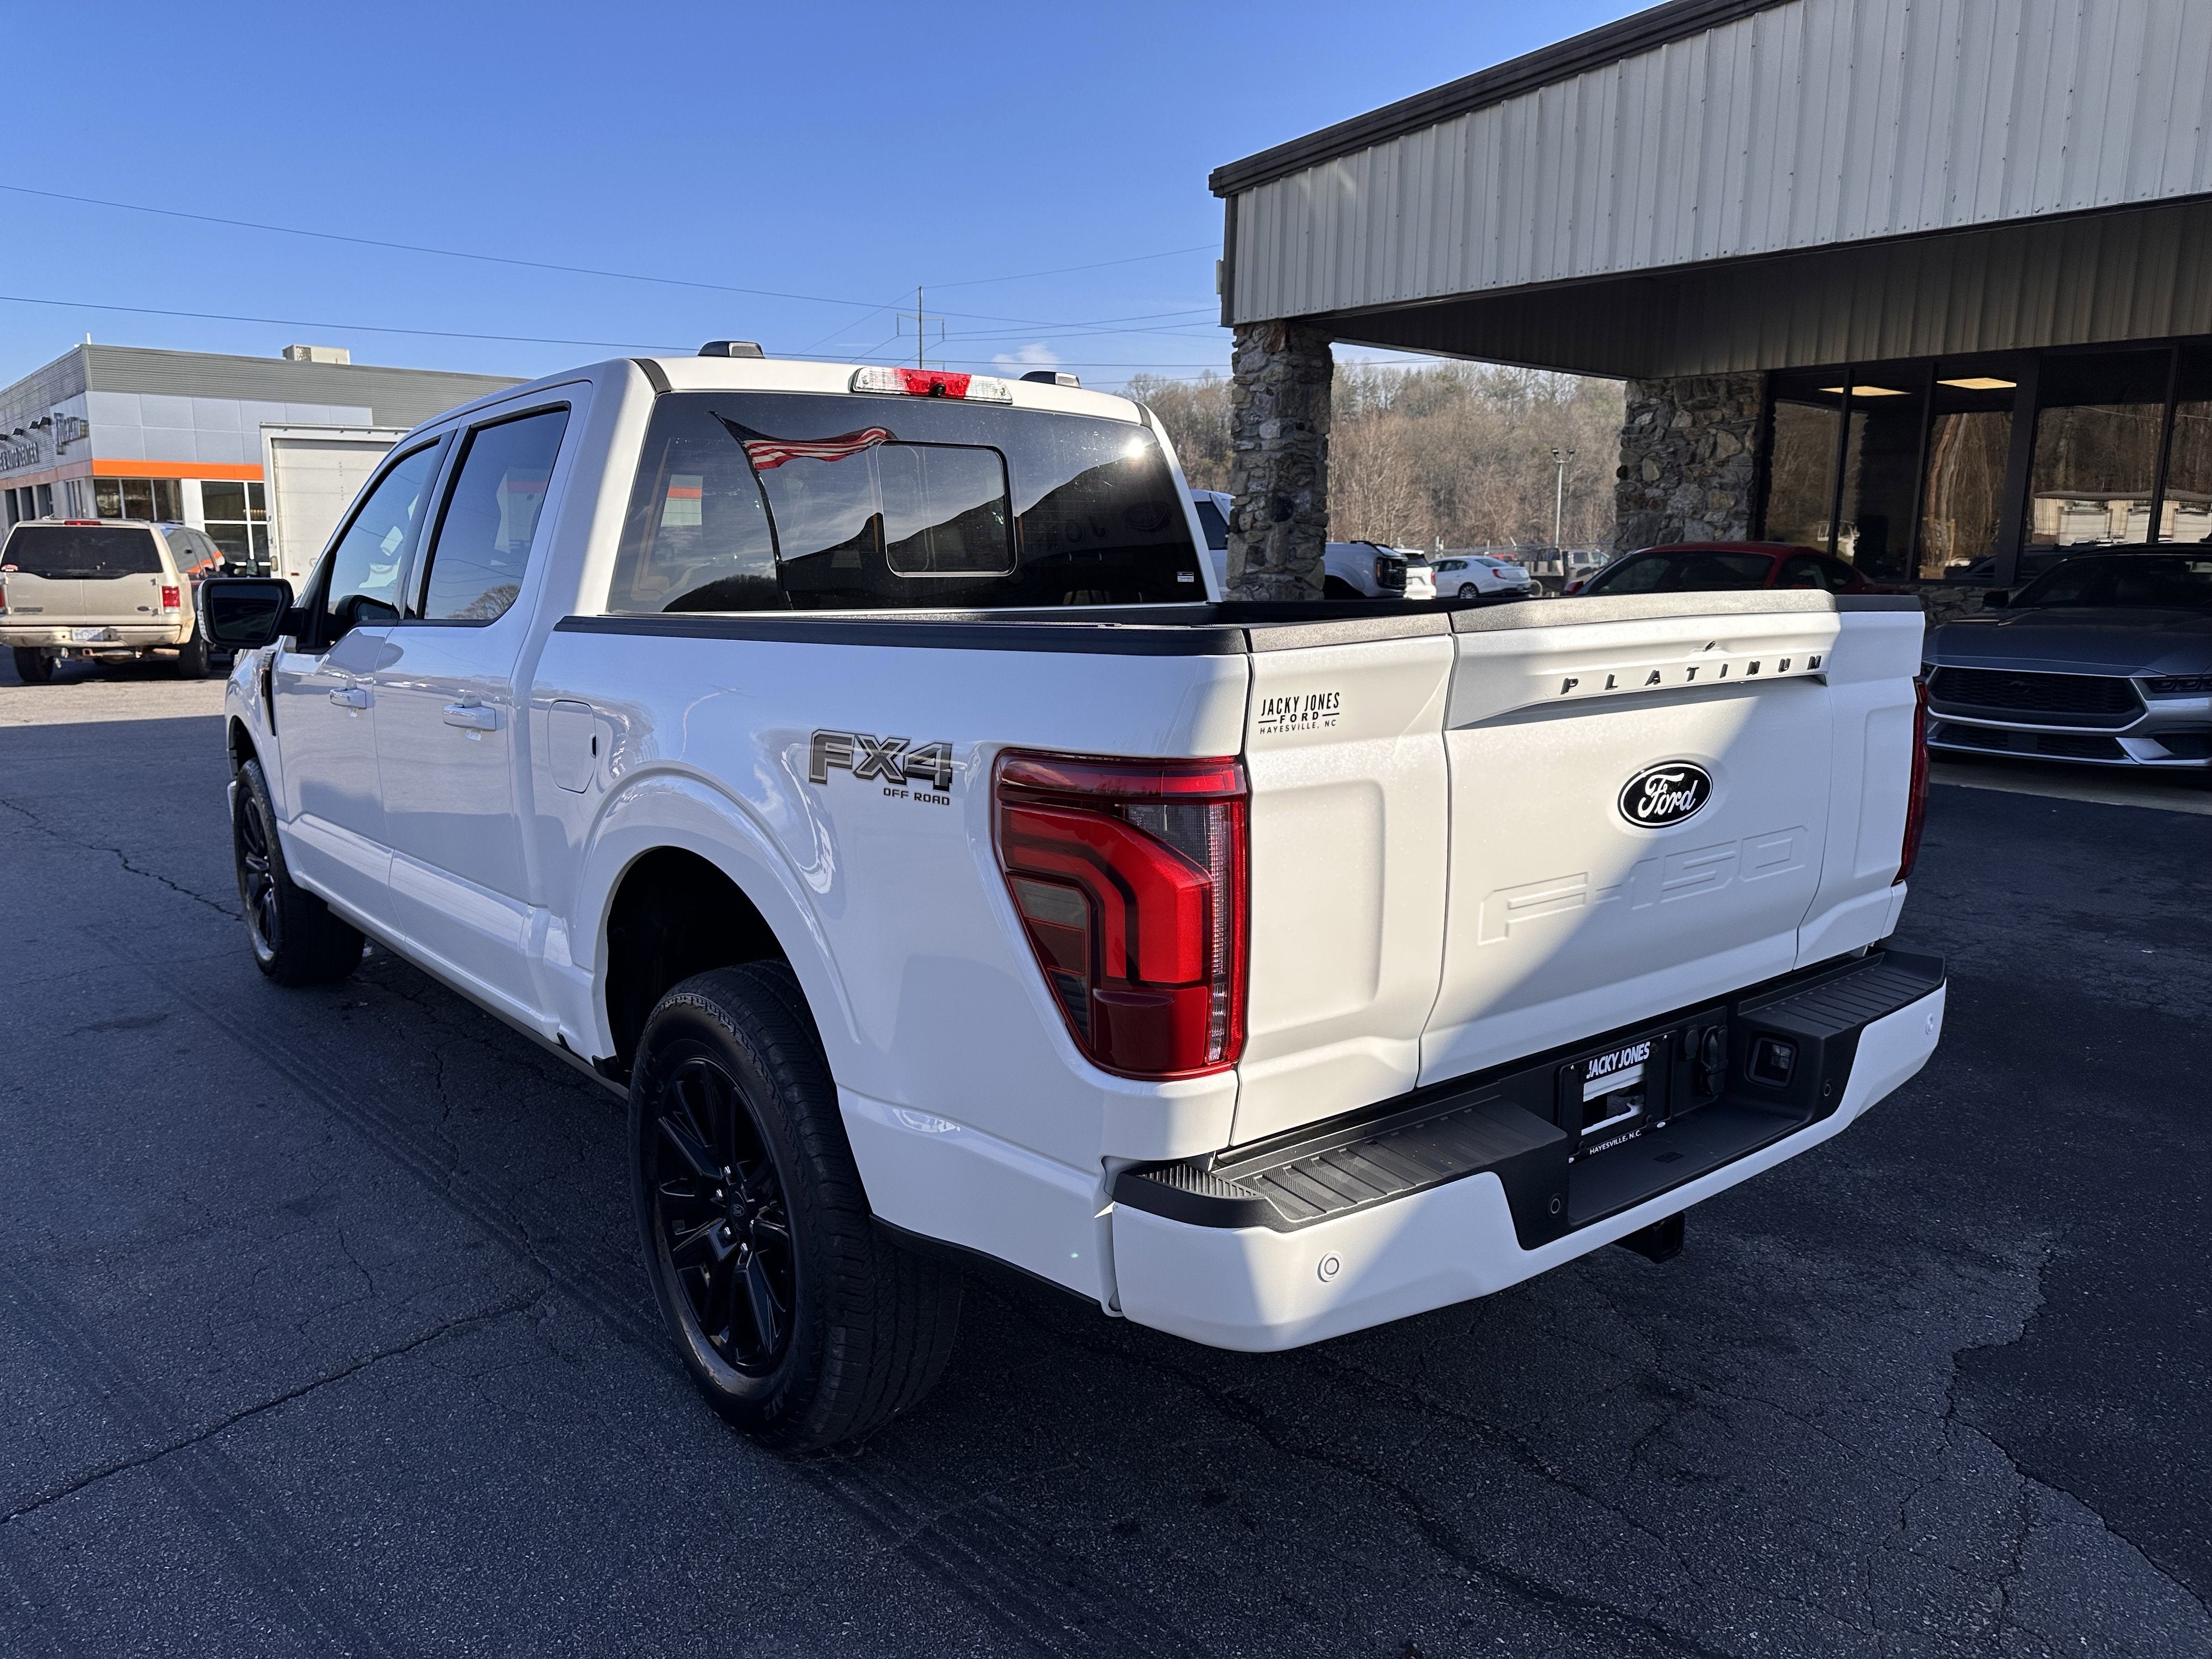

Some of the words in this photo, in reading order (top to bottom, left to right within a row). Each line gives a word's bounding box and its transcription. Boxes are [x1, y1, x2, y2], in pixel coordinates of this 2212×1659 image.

[1560, 656, 1821, 695] PLATINUM
[1261, 696, 1300, 716] JACKY
[1304, 692, 1340, 712] JONES
[1260, 721, 1319, 735] HAYESVILLE,
[1325, 719, 1336, 727] NC
[1280, 712, 1319, 724] FORD
[809, 729, 953, 792] FX4
[883, 788, 909, 799] OFF
[914, 791, 950, 806] ROAD
[1638, 772, 1697, 818] Ford
[1586, 1052, 1620, 1079] JACKY
[1618, 1041, 1650, 1068] JONES
[1590, 1136, 1628, 1155] HAYESVILLE,
[1629, 1130, 1642, 1139] N.C.
